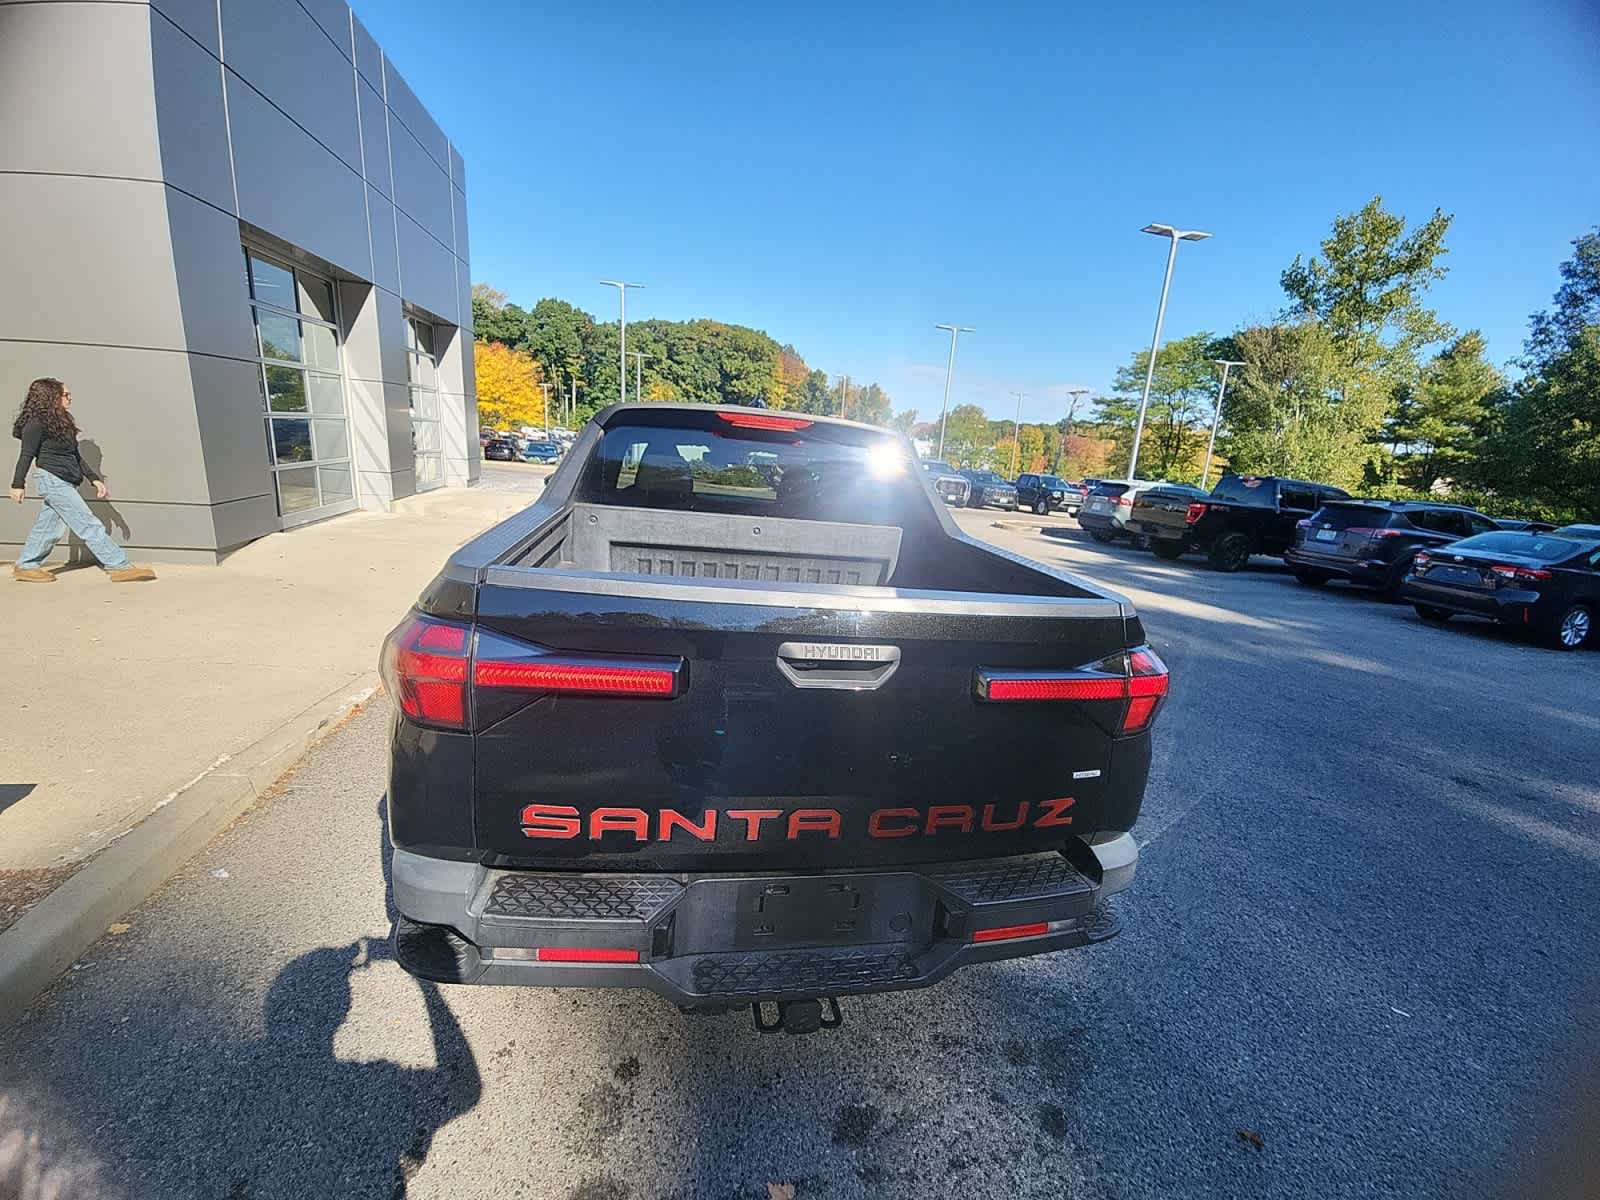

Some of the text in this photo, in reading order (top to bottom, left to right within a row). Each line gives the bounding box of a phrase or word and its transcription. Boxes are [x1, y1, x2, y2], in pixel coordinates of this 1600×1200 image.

[804, 645, 880, 660] HYUNDAI
[520, 797, 1076, 841] SANTA CRUZ
